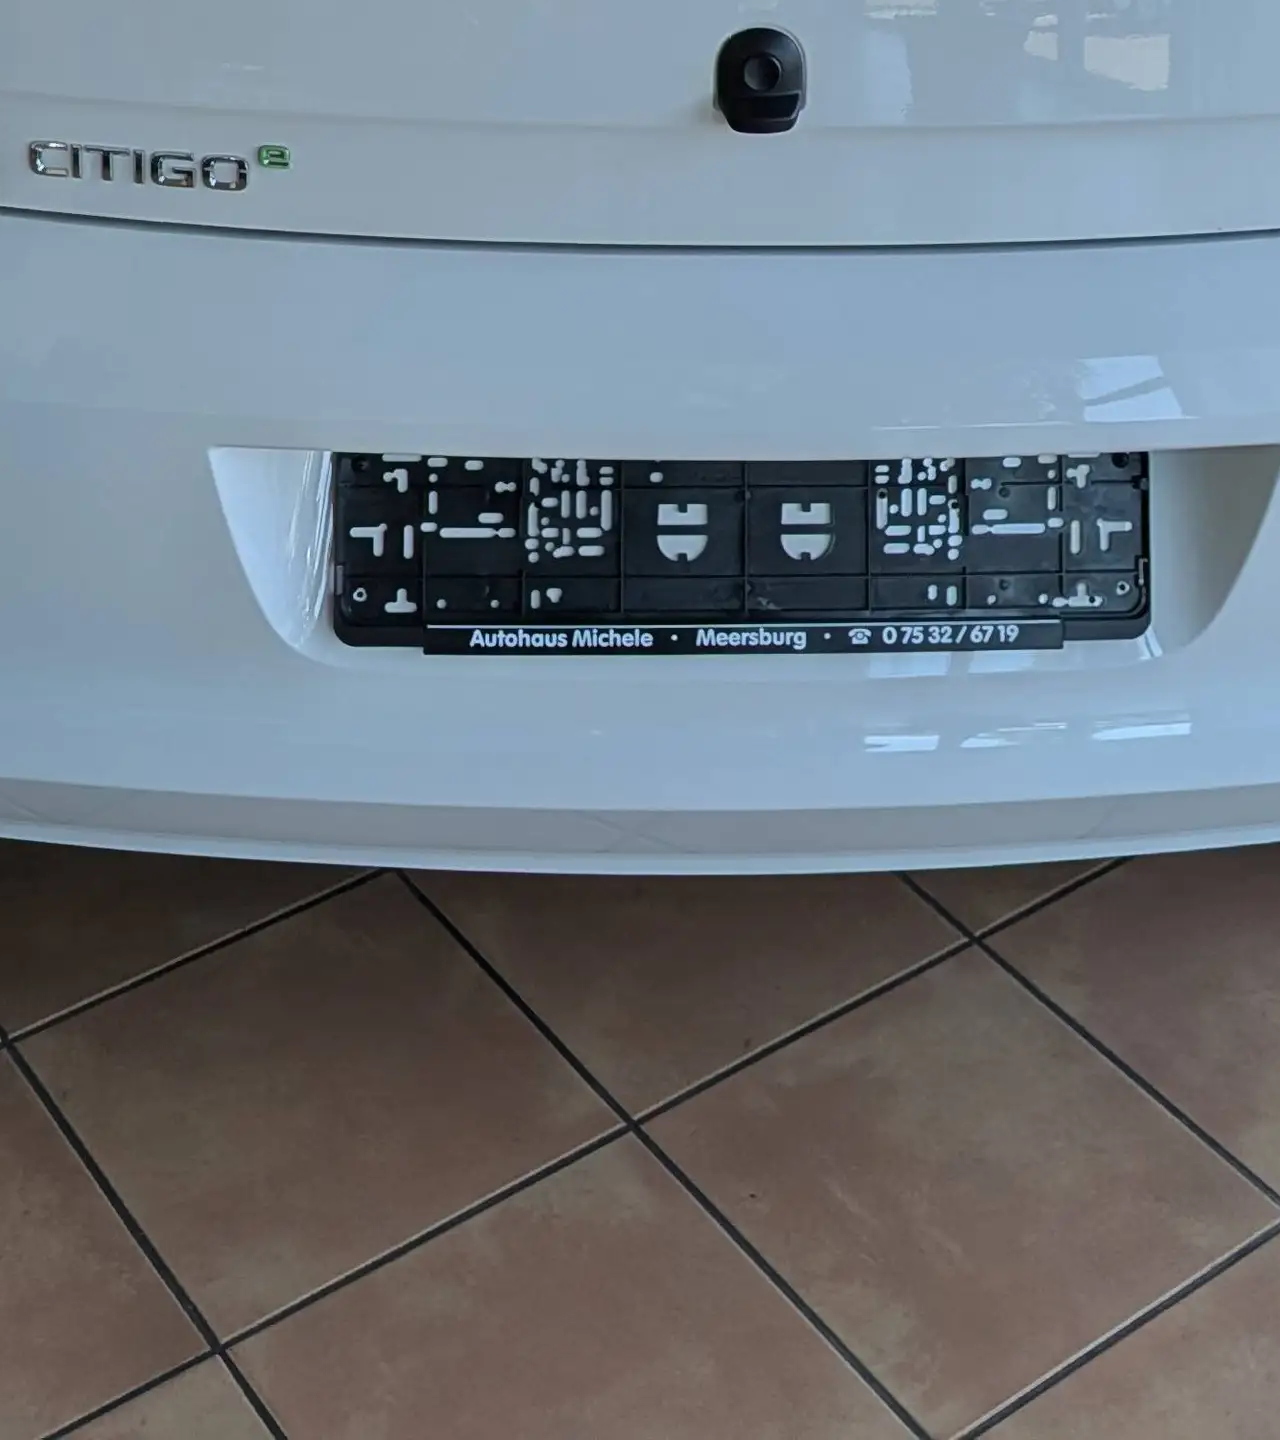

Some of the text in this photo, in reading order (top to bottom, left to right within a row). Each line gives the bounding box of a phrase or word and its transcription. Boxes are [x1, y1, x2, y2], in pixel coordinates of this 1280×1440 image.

[470, 628, 568, 648] Autohaus
[571, 628, 654, 648] Michele
[695, 626, 807, 650] Meersburg
